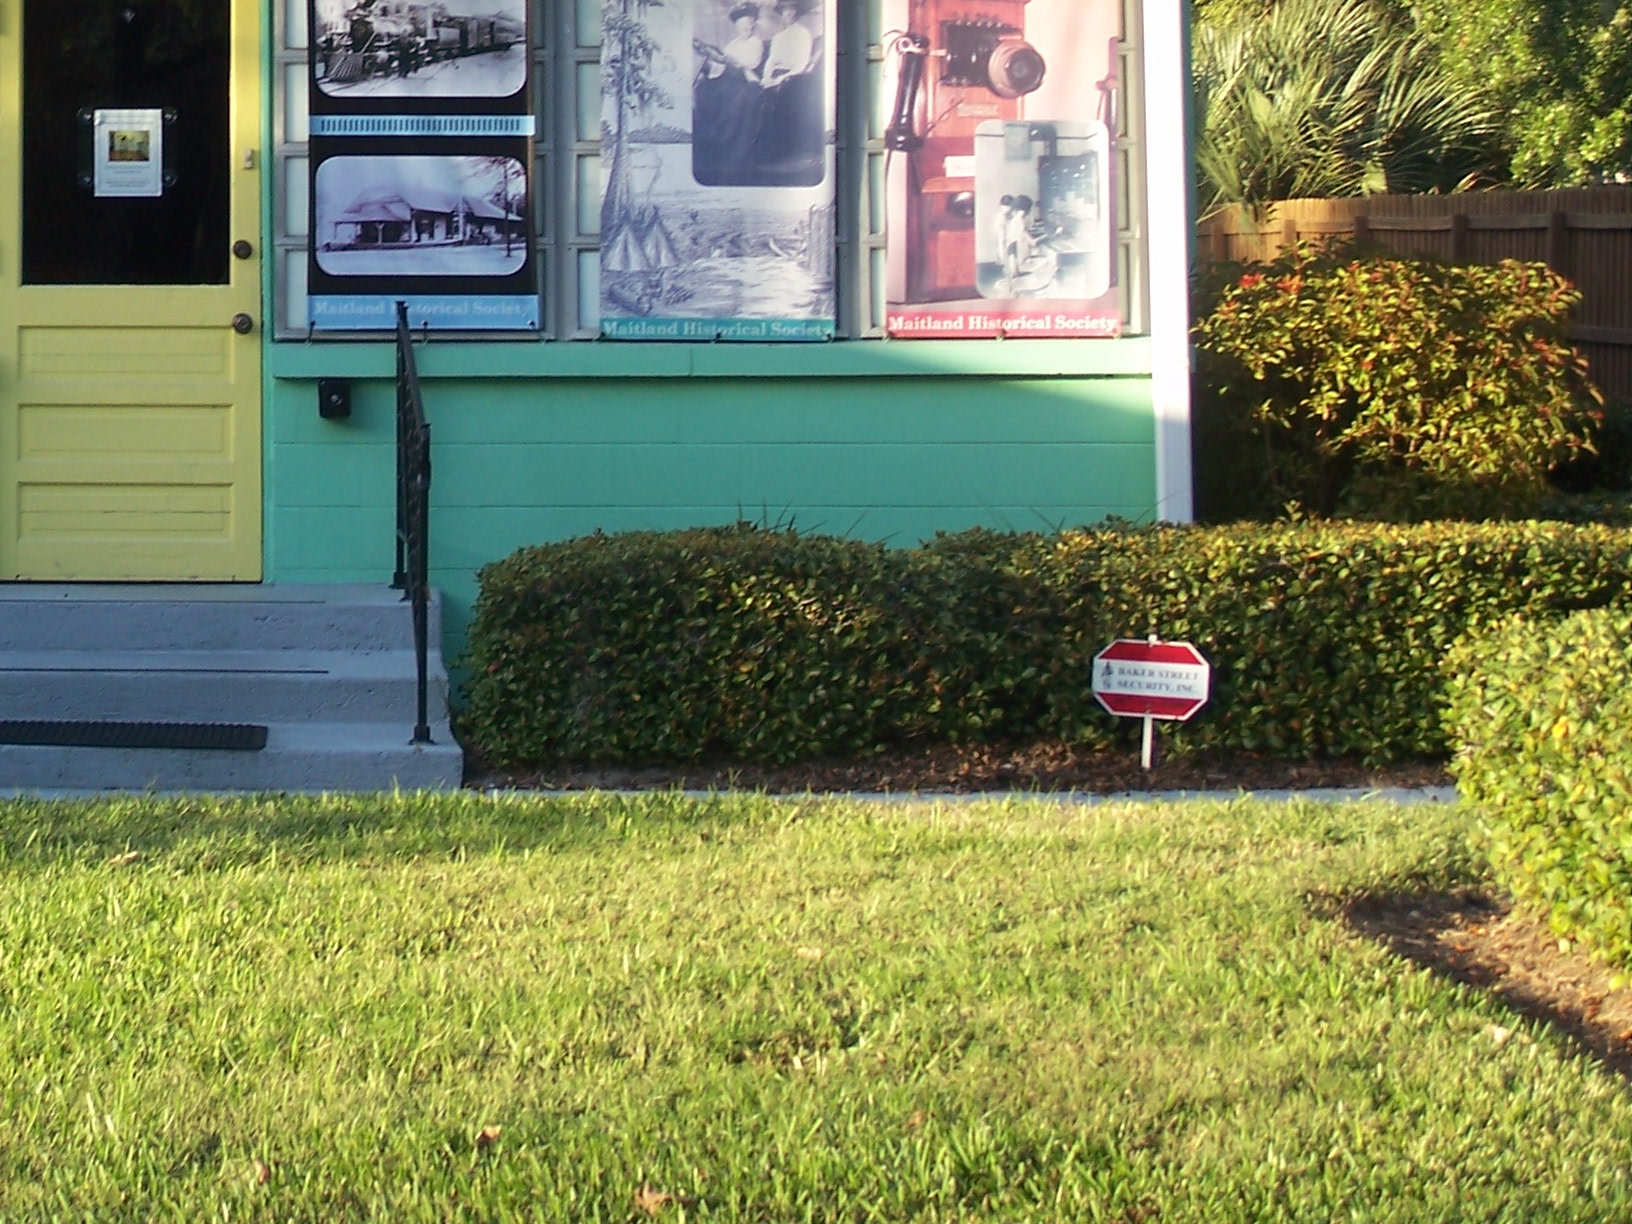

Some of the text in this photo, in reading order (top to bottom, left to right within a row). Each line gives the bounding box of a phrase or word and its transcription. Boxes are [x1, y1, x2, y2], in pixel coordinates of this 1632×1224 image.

[313, 300, 384, 316] Maitland
[473, 300, 530, 318] Society
[603, 320, 678, 336] Maitland
[889, 315, 1118, 333] Maitland Historical Society
[1118, 666, 1198, 680] BAKER STREET
